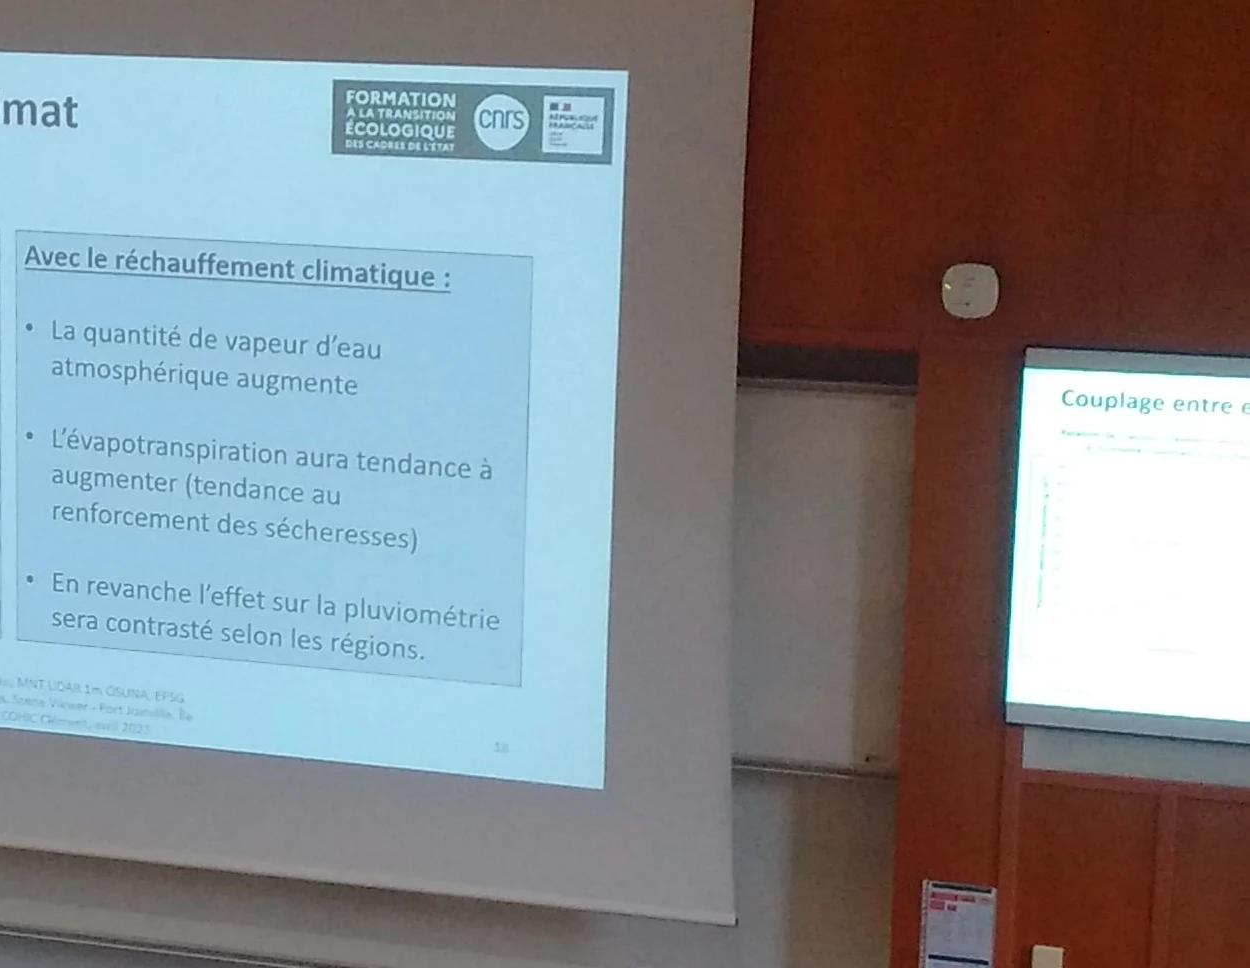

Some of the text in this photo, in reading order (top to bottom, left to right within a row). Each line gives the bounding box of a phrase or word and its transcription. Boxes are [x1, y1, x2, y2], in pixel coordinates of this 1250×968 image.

[346, 89, 457, 107] FORMATION
[358, 109, 374, 119] LA
[377, 109, 456, 121] TRANSITION
[345, 120, 456, 140] ÉCOLOGIQUE
[479, 108, 524, 130] cnrs
[409, 142, 422, 151] DE
[25, 245, 80, 270] Avec
[87, 248, 108, 270] le
[115, 249, 295, 281] réchauffement
[302, 258, 435, 290] climatique
[52, 321, 382, 361] La quantité de vapeur d'eau
[52, 358, 358, 397] atmosphérique augmente
[1061, 389, 1164, 414] Couplage
[1173, 398, 1232, 414] entre
[52, 429, 492, 480] L'évapotranspiration aura tendance à
[52, 468, 341, 506] augmenter (tendance au
[52, 502, 419, 555] renforcement des sécheresses)
[52, 573, 501, 632] En revanche l'effet sur la pluviométrie
[52, 610, 426, 662] sera contrasté selon les régions.
